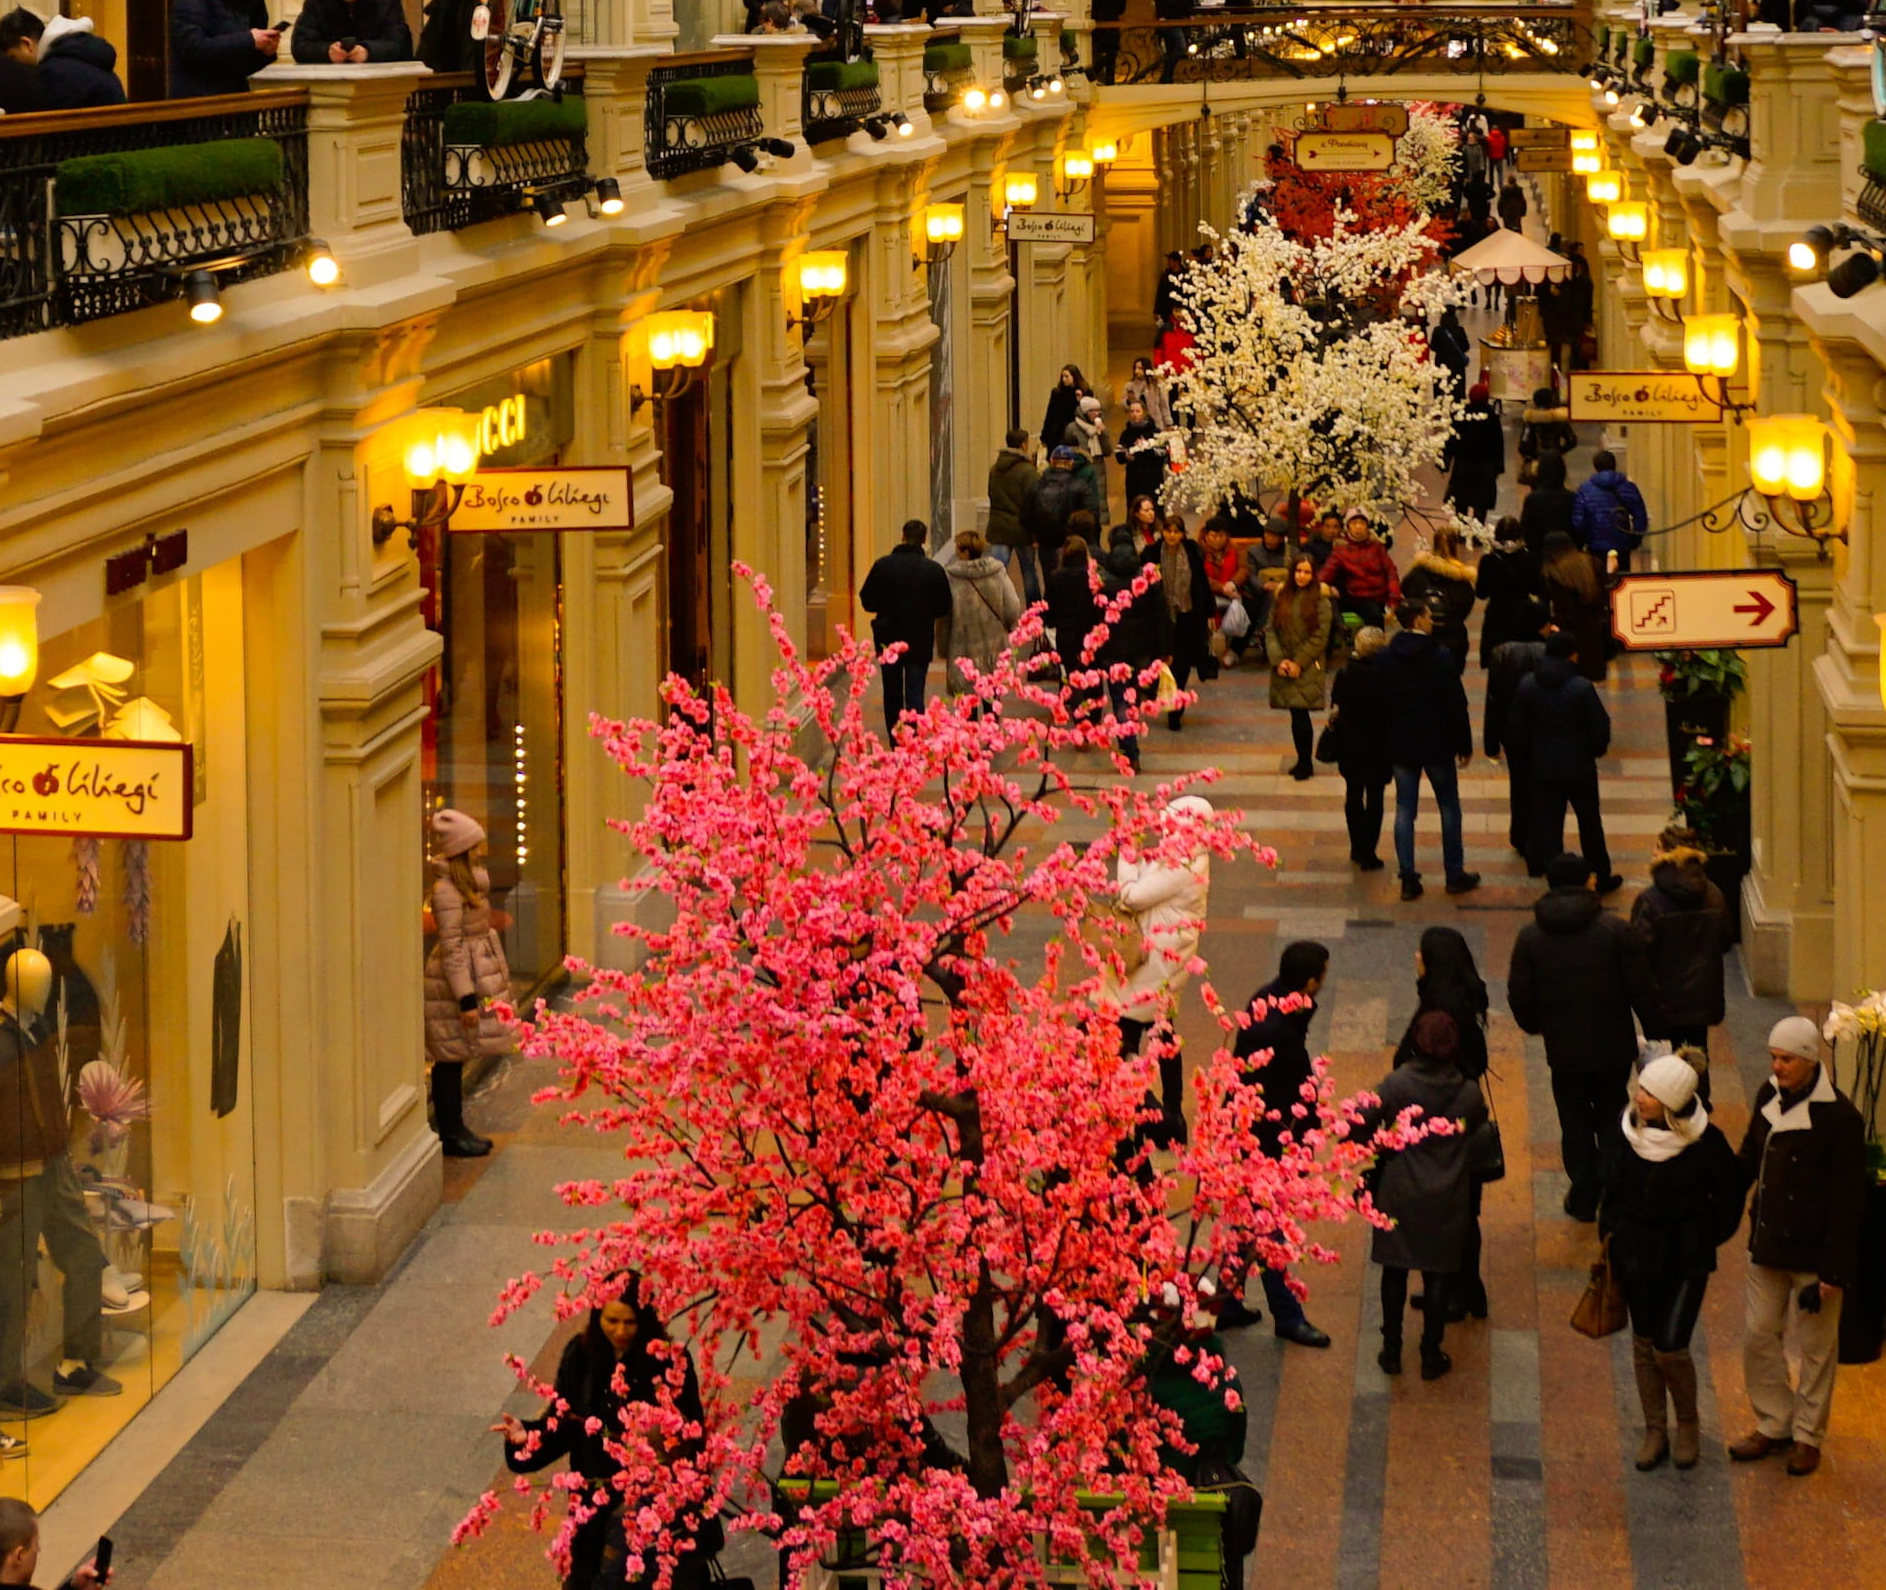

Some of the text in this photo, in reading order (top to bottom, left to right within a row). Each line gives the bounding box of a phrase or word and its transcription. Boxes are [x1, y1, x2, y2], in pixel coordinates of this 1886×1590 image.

[1584, 383, 1631, 407] Bosco
[476, 393, 526, 456] CCI
[464, 485, 521, 513] Bosco
[510, 515, 560, 524] FAMILY
[11, 809, 83, 823] FAMILY
